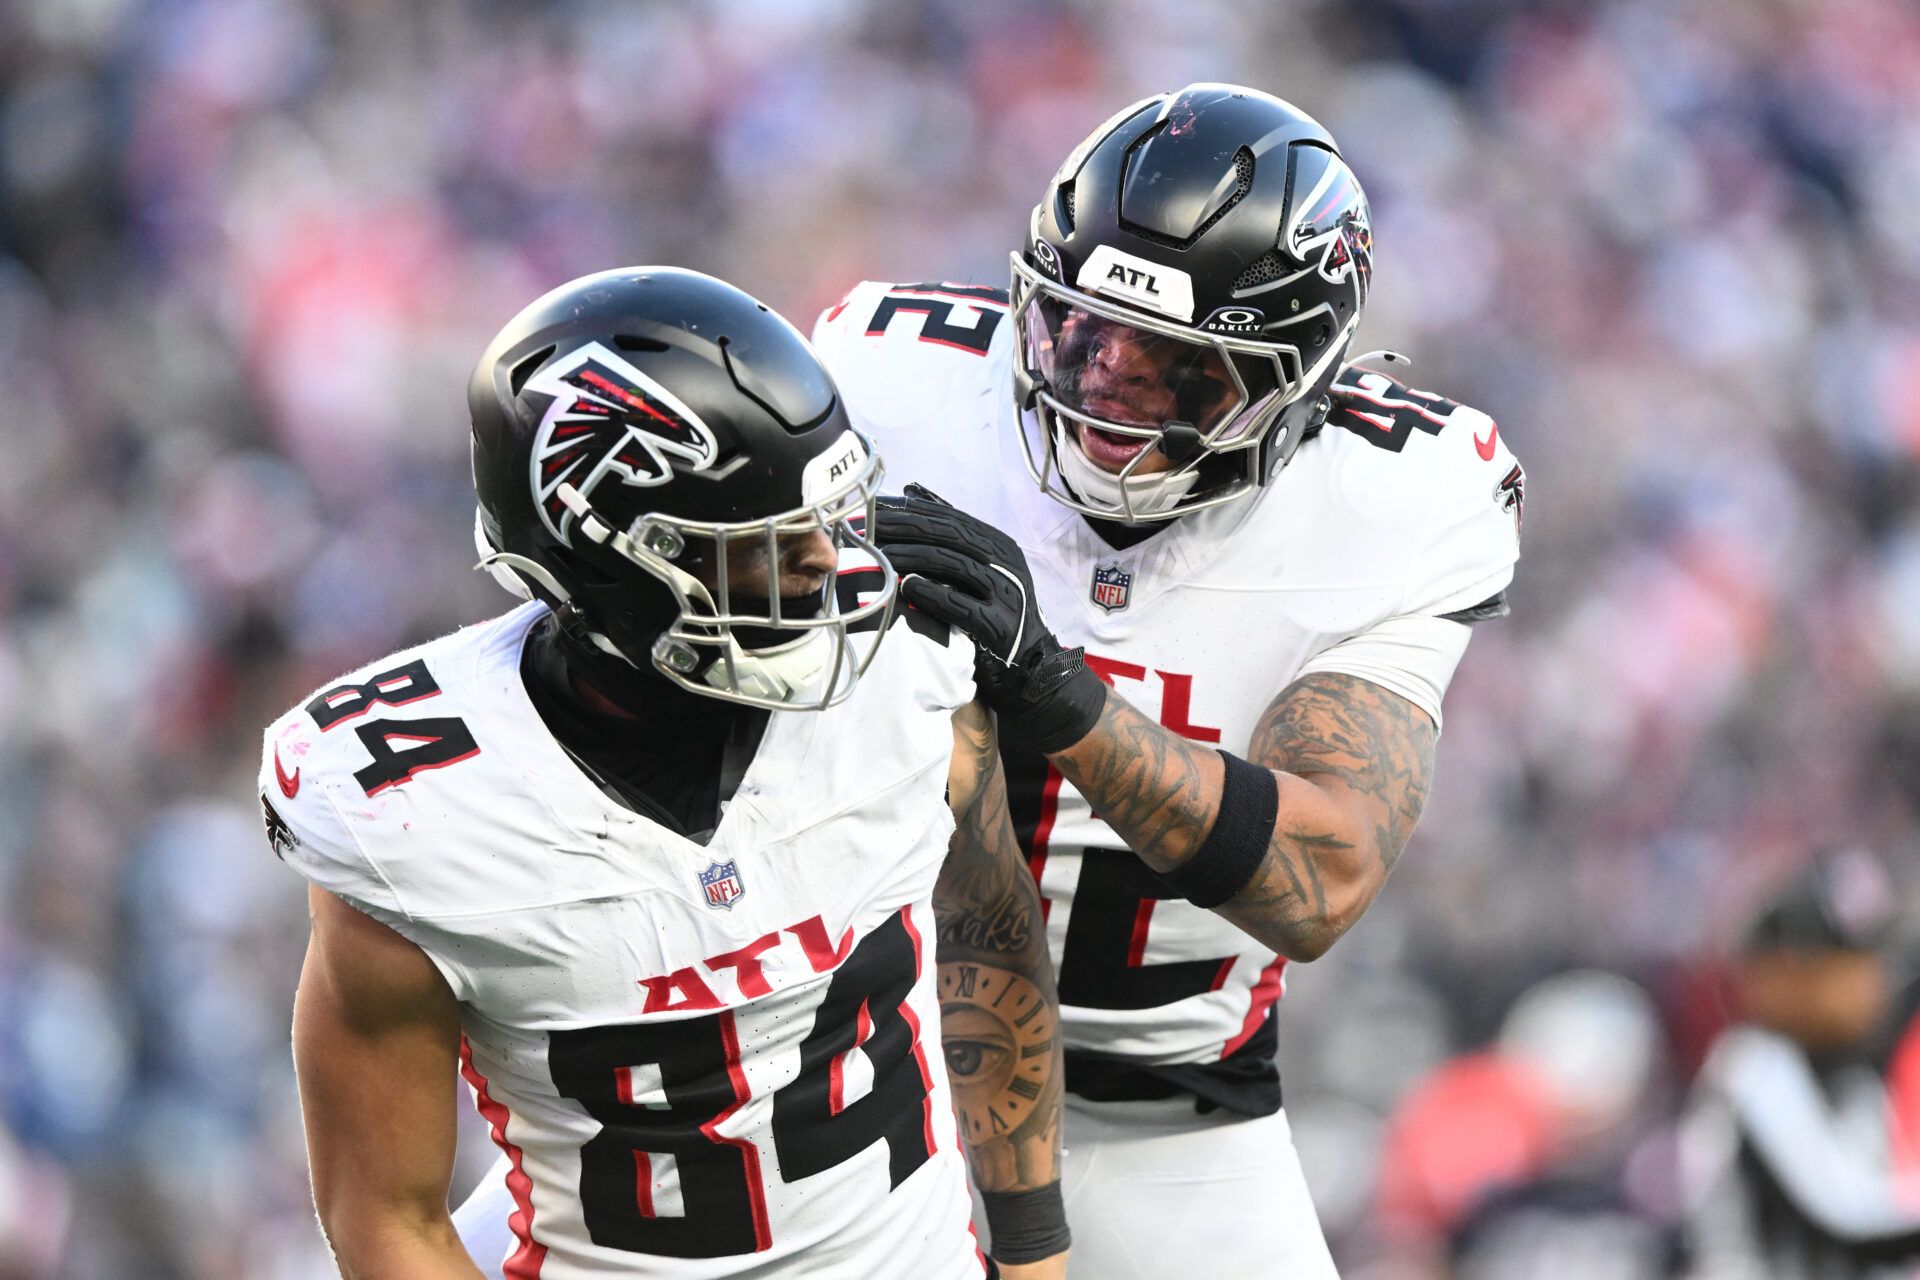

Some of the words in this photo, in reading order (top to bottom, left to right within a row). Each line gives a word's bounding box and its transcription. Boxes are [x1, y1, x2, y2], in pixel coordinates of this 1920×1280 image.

[1107, 263, 1160, 295] ATL
[1208, 323, 1261, 331] OAKLEY
[829, 449, 858, 482] ATL
[1096, 583, 1124, 606] NFL
[304, 658, 481, 798] 84
[707, 878, 740, 903] NFL
[637, 913, 855, 1014] ATL
[547, 904, 938, 1260] 84
